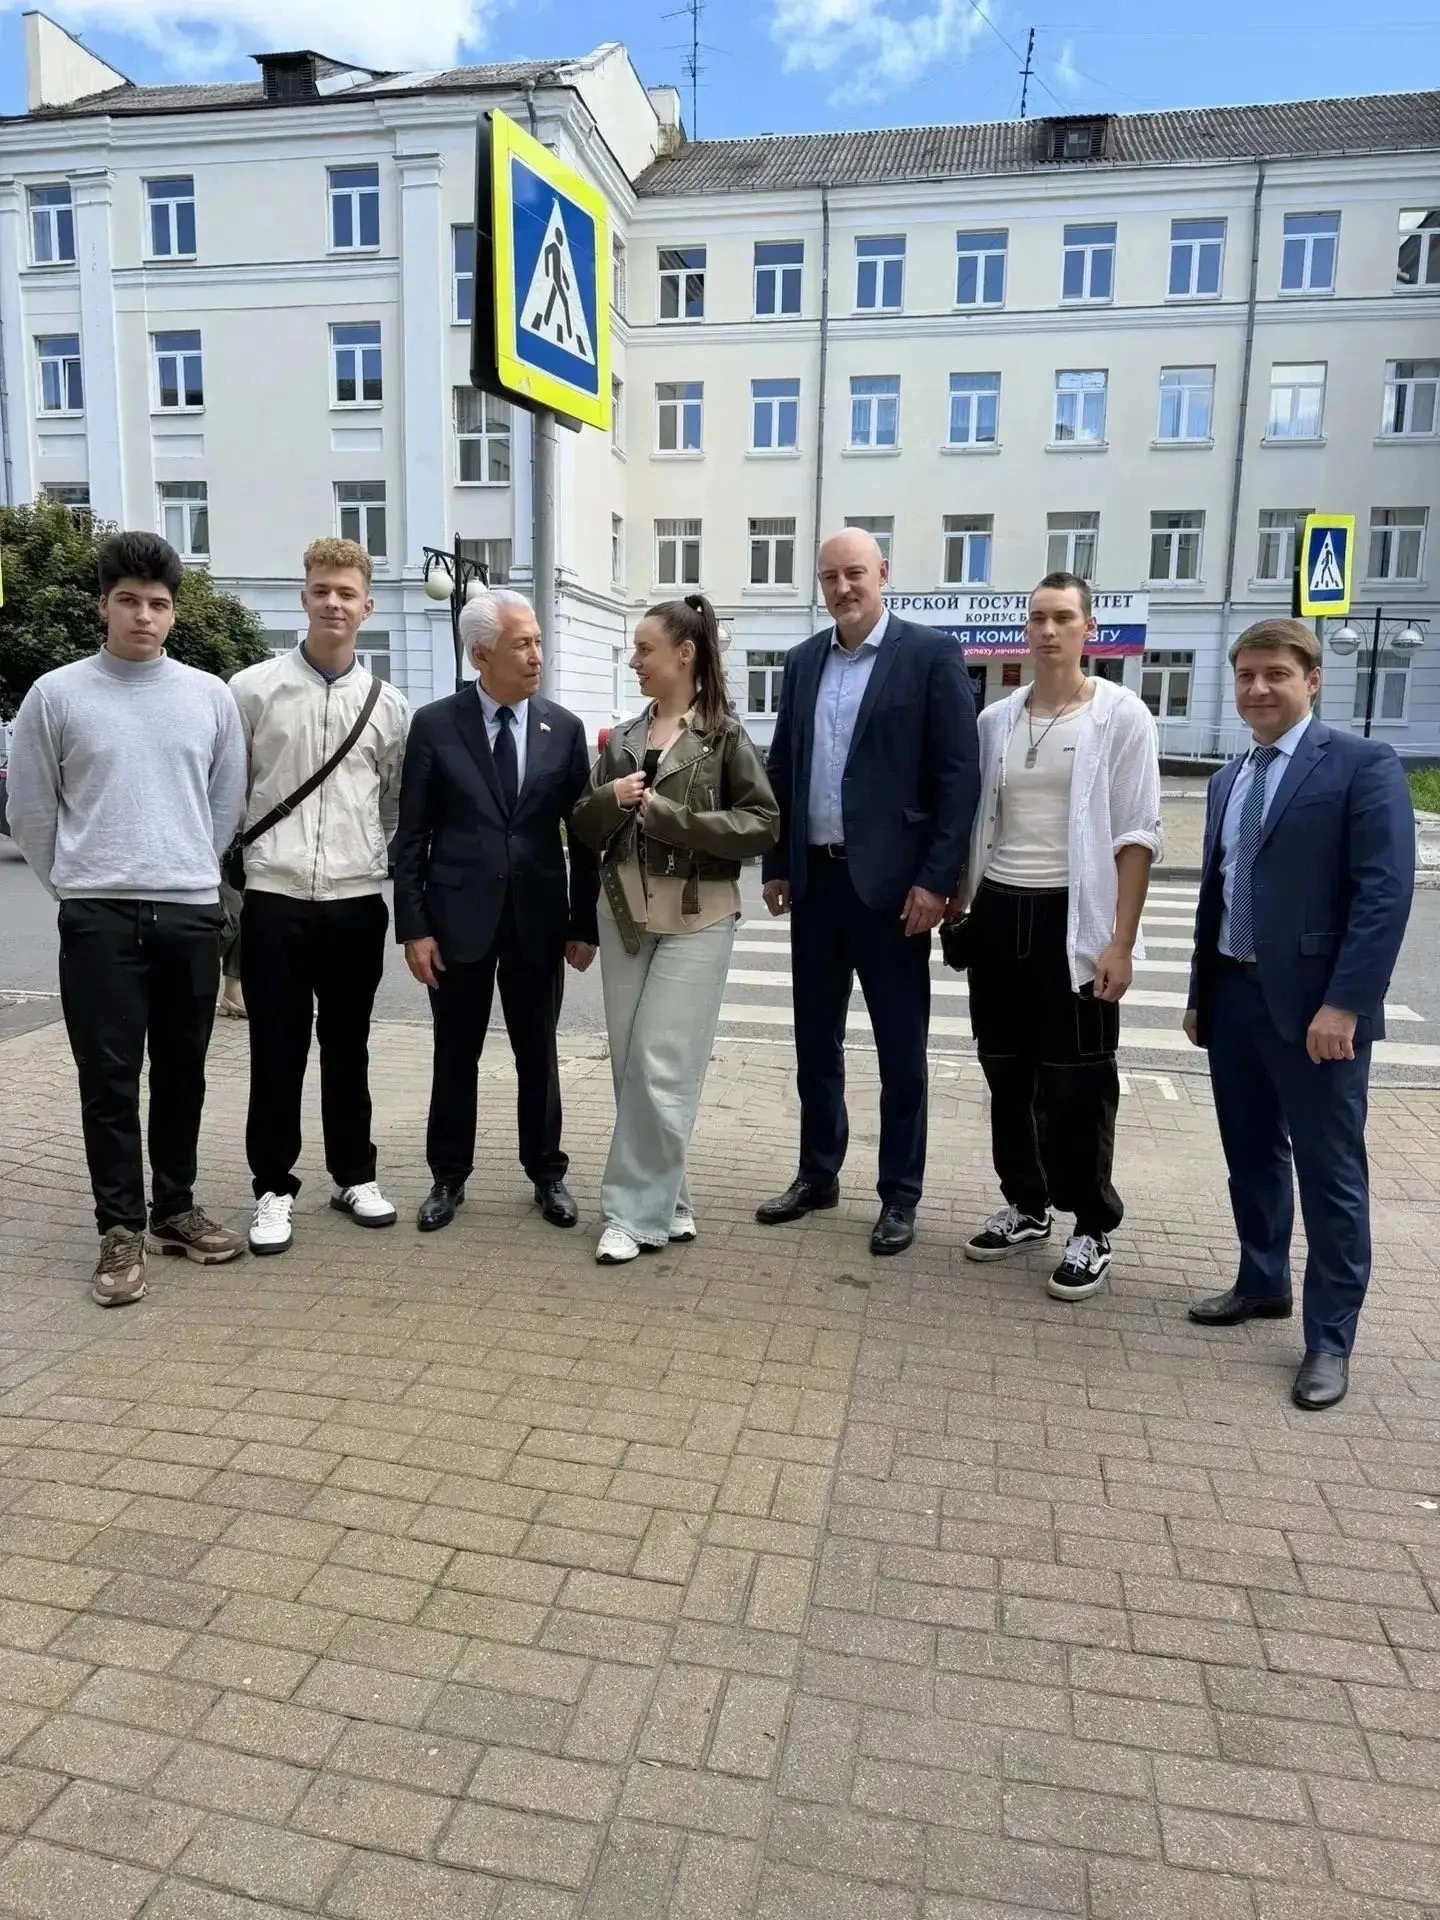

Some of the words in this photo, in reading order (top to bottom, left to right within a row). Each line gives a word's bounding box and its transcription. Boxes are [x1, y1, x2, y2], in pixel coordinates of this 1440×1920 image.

[881, 593, 959, 610] ВЕРСКОЙ
[969, 595, 1133, 610] ГОСУНИТЕТ
[966, 613, 1016, 623] КОРПУС
[976, 630, 1025, 643] КОМИ
[1088, 630, 1121, 642] ВГУ
